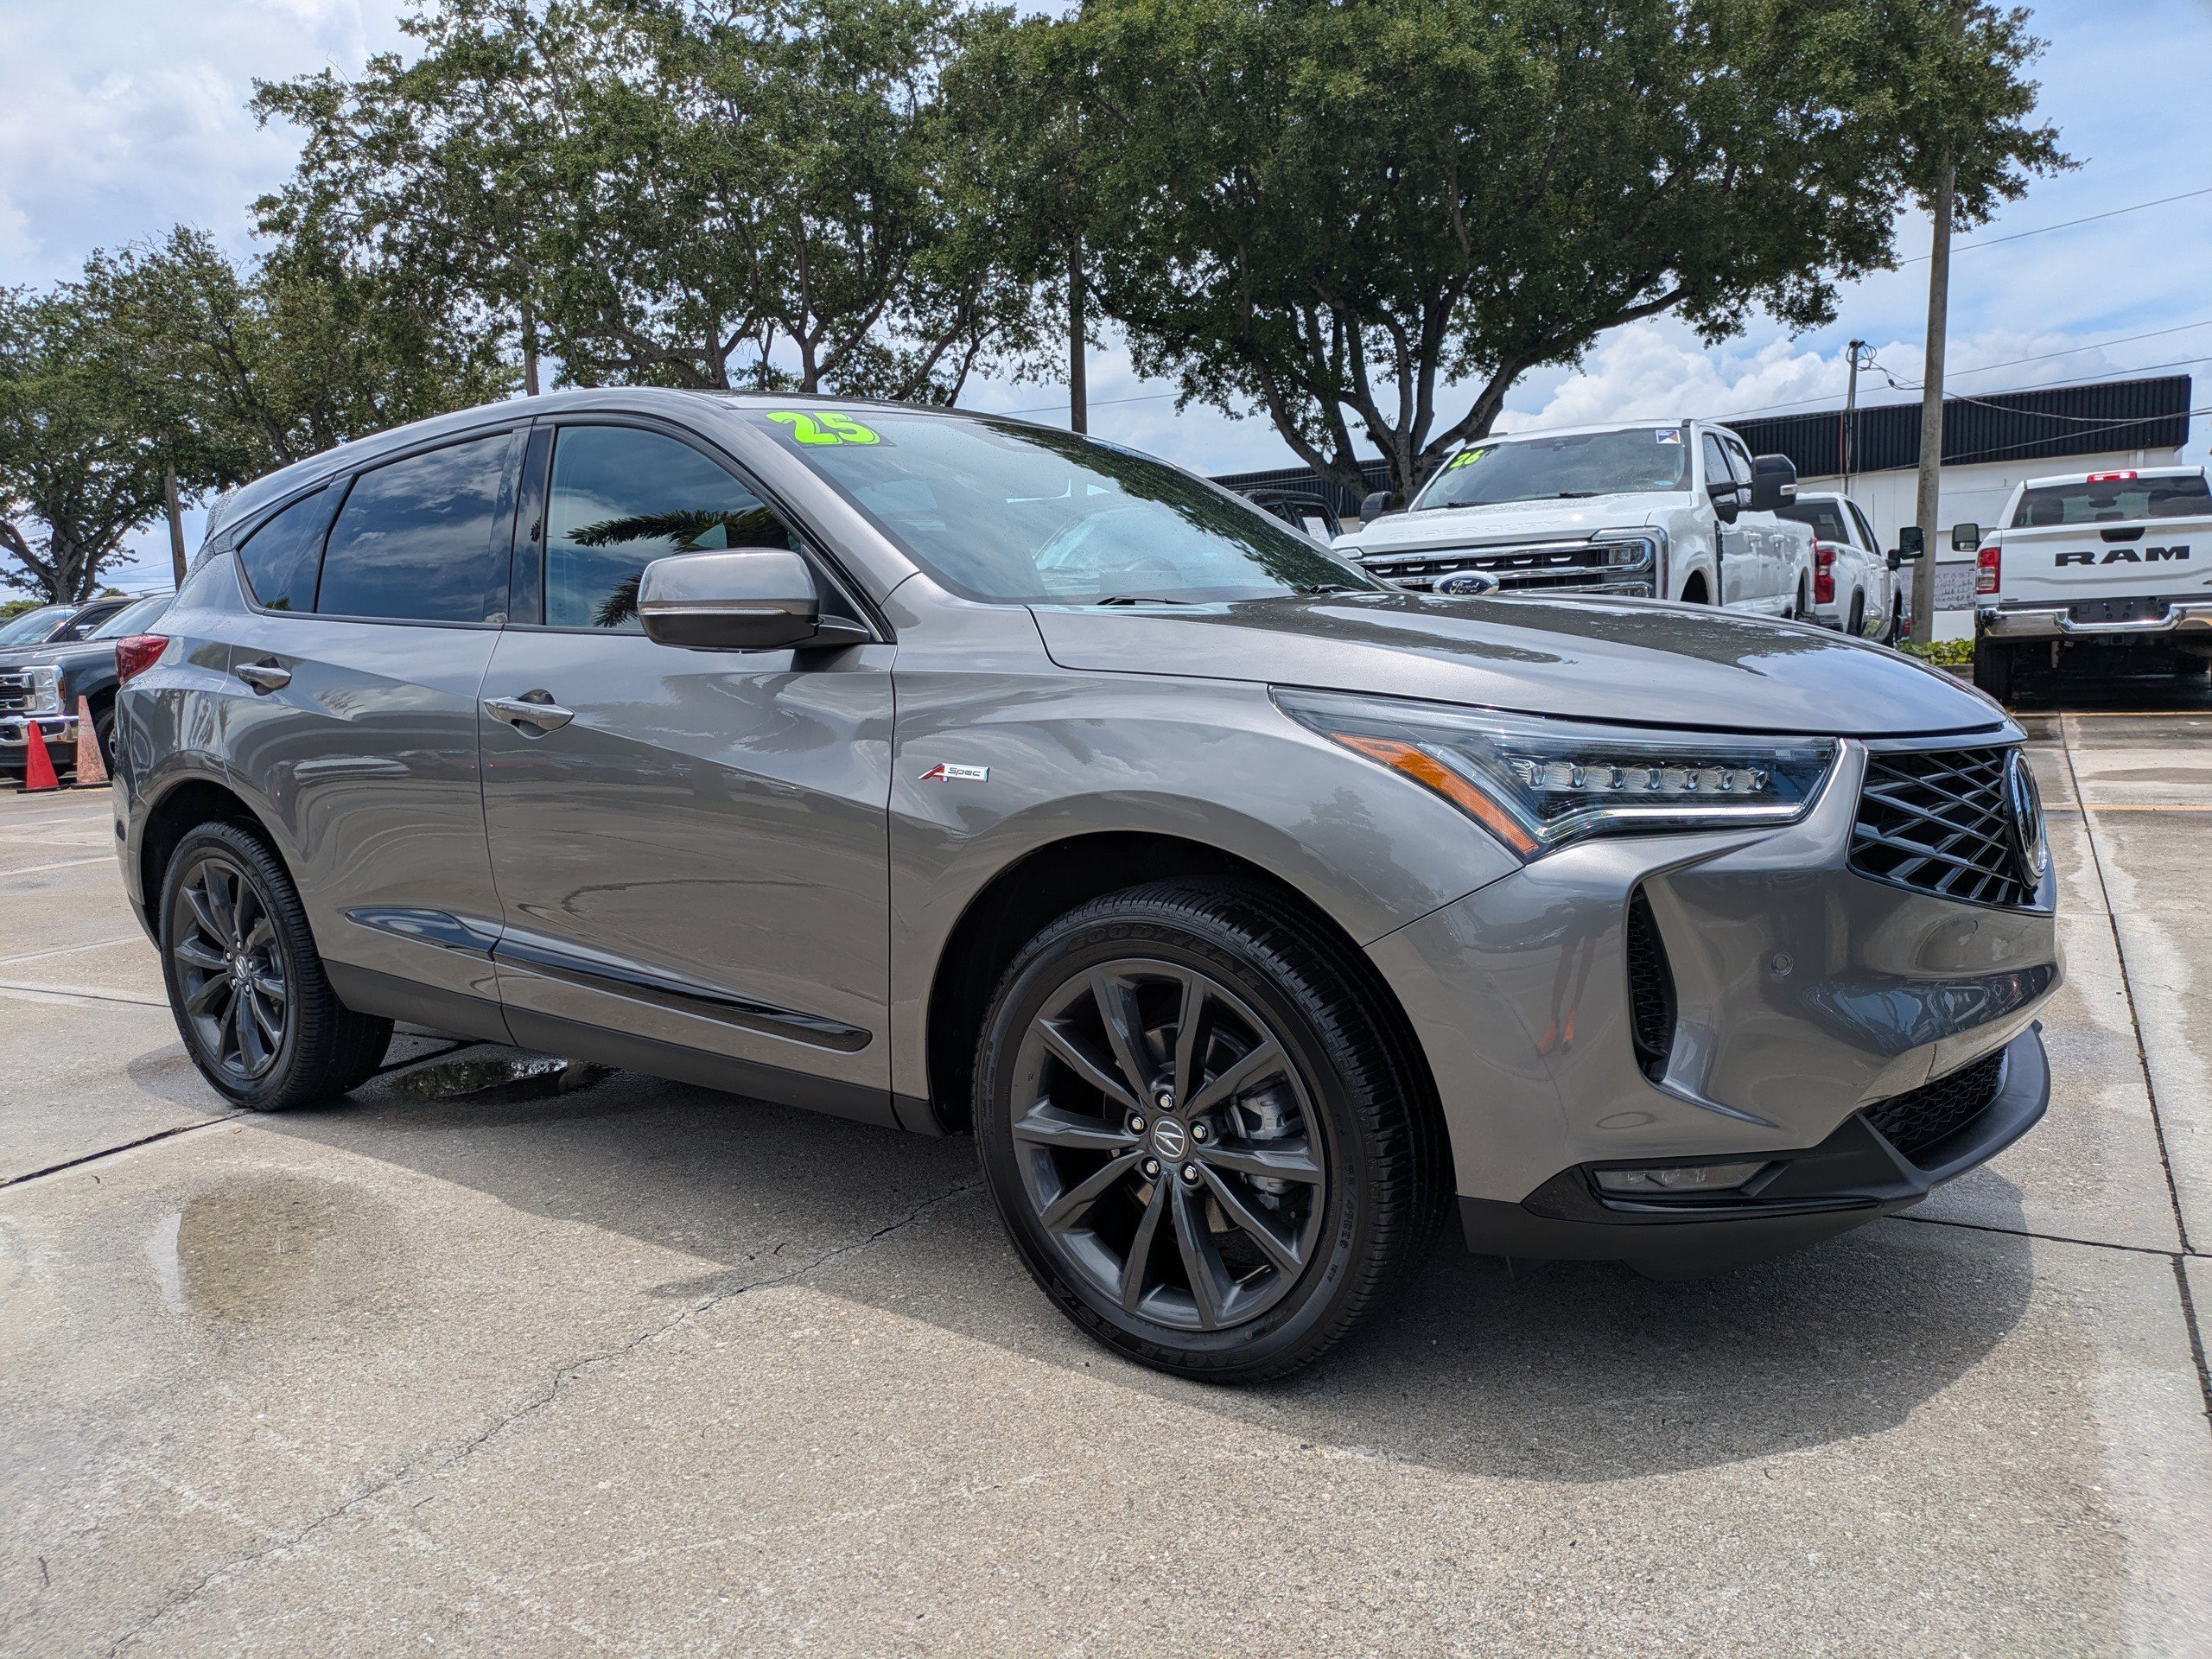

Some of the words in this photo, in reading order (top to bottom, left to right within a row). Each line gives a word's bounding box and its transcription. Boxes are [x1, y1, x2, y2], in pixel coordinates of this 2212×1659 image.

[766, 411, 880, 445] 25
[1449, 449, 1484, 468] 26
[1388, 526, 1478, 540] SUPER
[1484, 520, 1562, 532] DUTY
[2055, 545, 2190, 567] RAM
[1448, 579, 1480, 595] Ford
[1067, 924, 1263, 989] GOODYEAR
[1136, 1344, 1252, 1370] EAGLE
